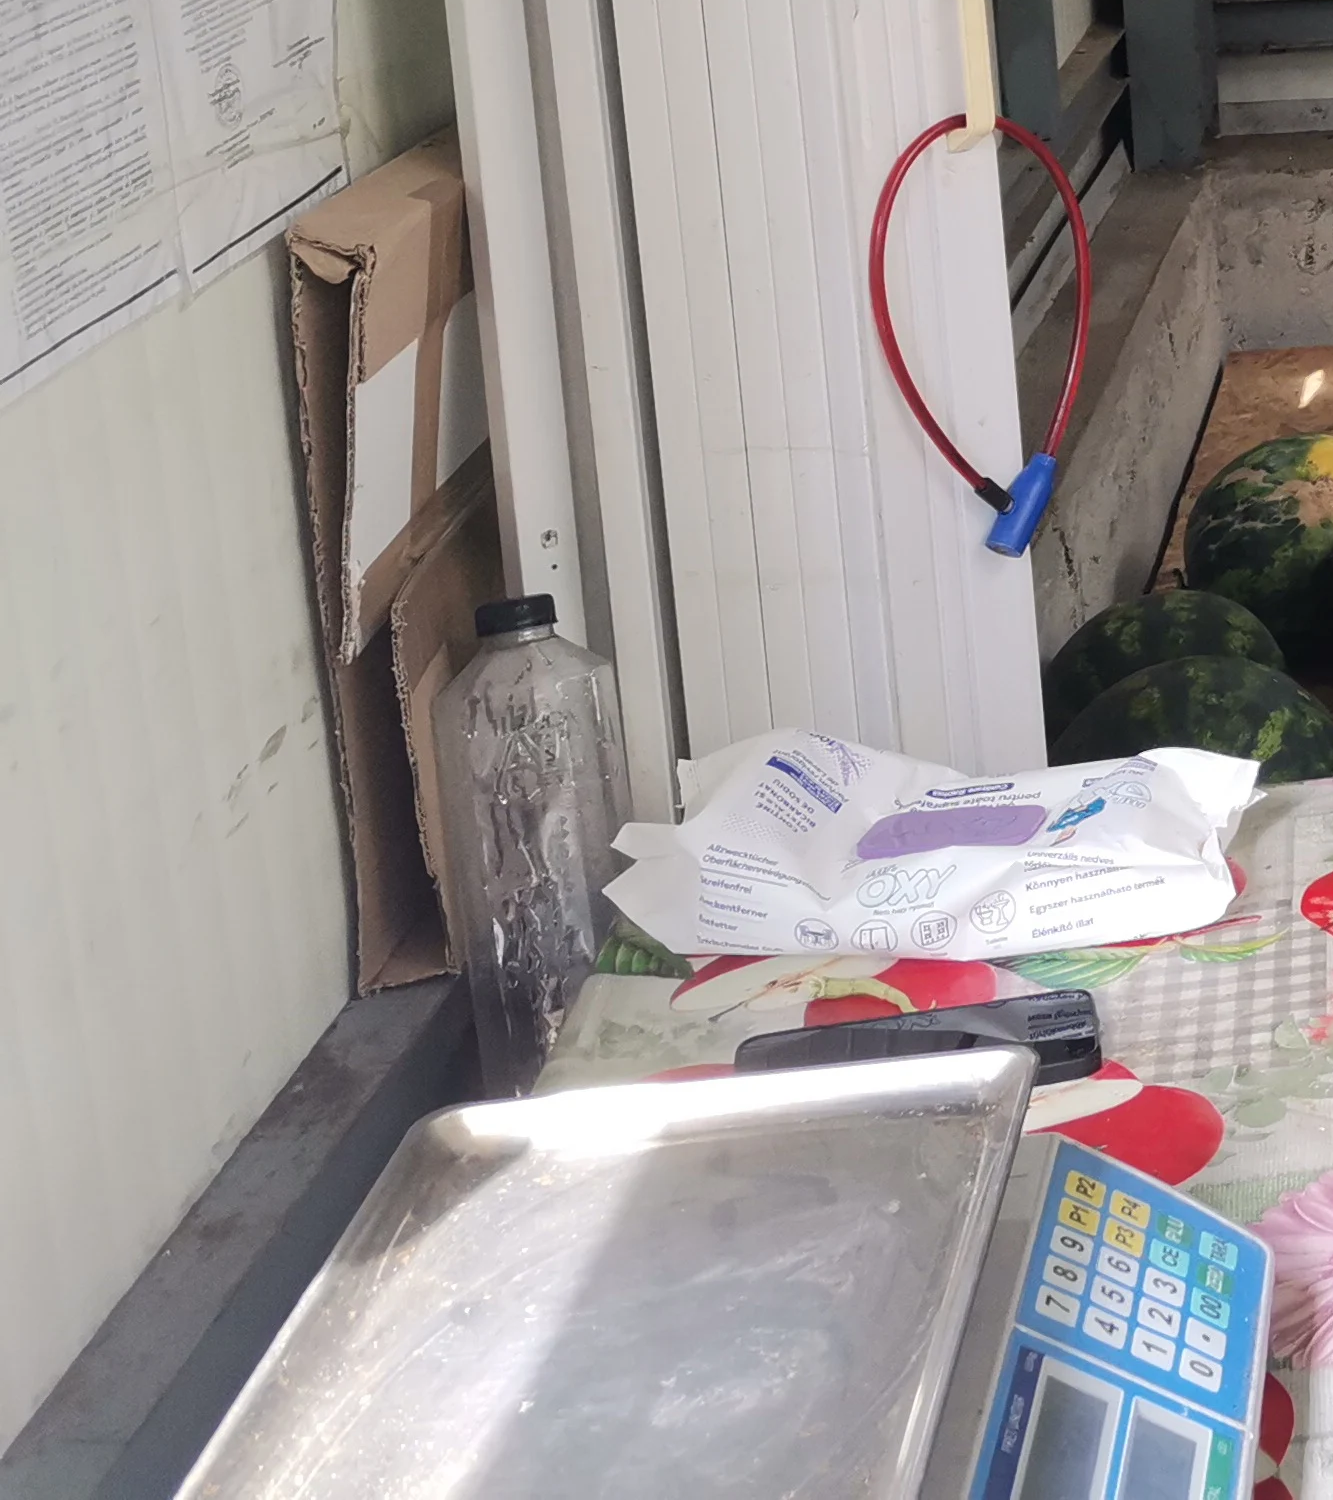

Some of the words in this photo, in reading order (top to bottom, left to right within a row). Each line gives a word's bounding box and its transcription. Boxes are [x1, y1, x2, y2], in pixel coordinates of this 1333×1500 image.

[758, 782, 817, 828] BICARBONAT
[962, 795, 997, 806] toate
[999, 791, 1041, 802] pentru
[856, 864, 957, 908] OXY
[1025, 875, 1073, 892] Könnyen
[1029, 899, 1068, 915] Egyszer
[1076, 1176, 1097, 1199] P2
[1069, 1204, 1091, 1226] P1
[1121, 1198, 1140, 1220] P4
[1060, 1235, 1084, 1253] 9
[1115, 1226, 1135, 1248] P3
[1107, 1257, 1131, 1274] 6
[1161, 1246, 1180, 1268] CE
[1053, 1264, 1078, 1282] 8
[1101, 1285, 1125, 1304] 5
[1153, 1277, 1178, 1295] 3
[1045, 1294, 1071, 1313] 7
[1200, 1294, 1222, 1320] 00
[1094, 1316, 1120, 1336] 4
[1147, 1307, 1173, 1327] 2
[1142, 1340, 1168, 1355] 1
[1189, 1360, 1214, 1378] 0
